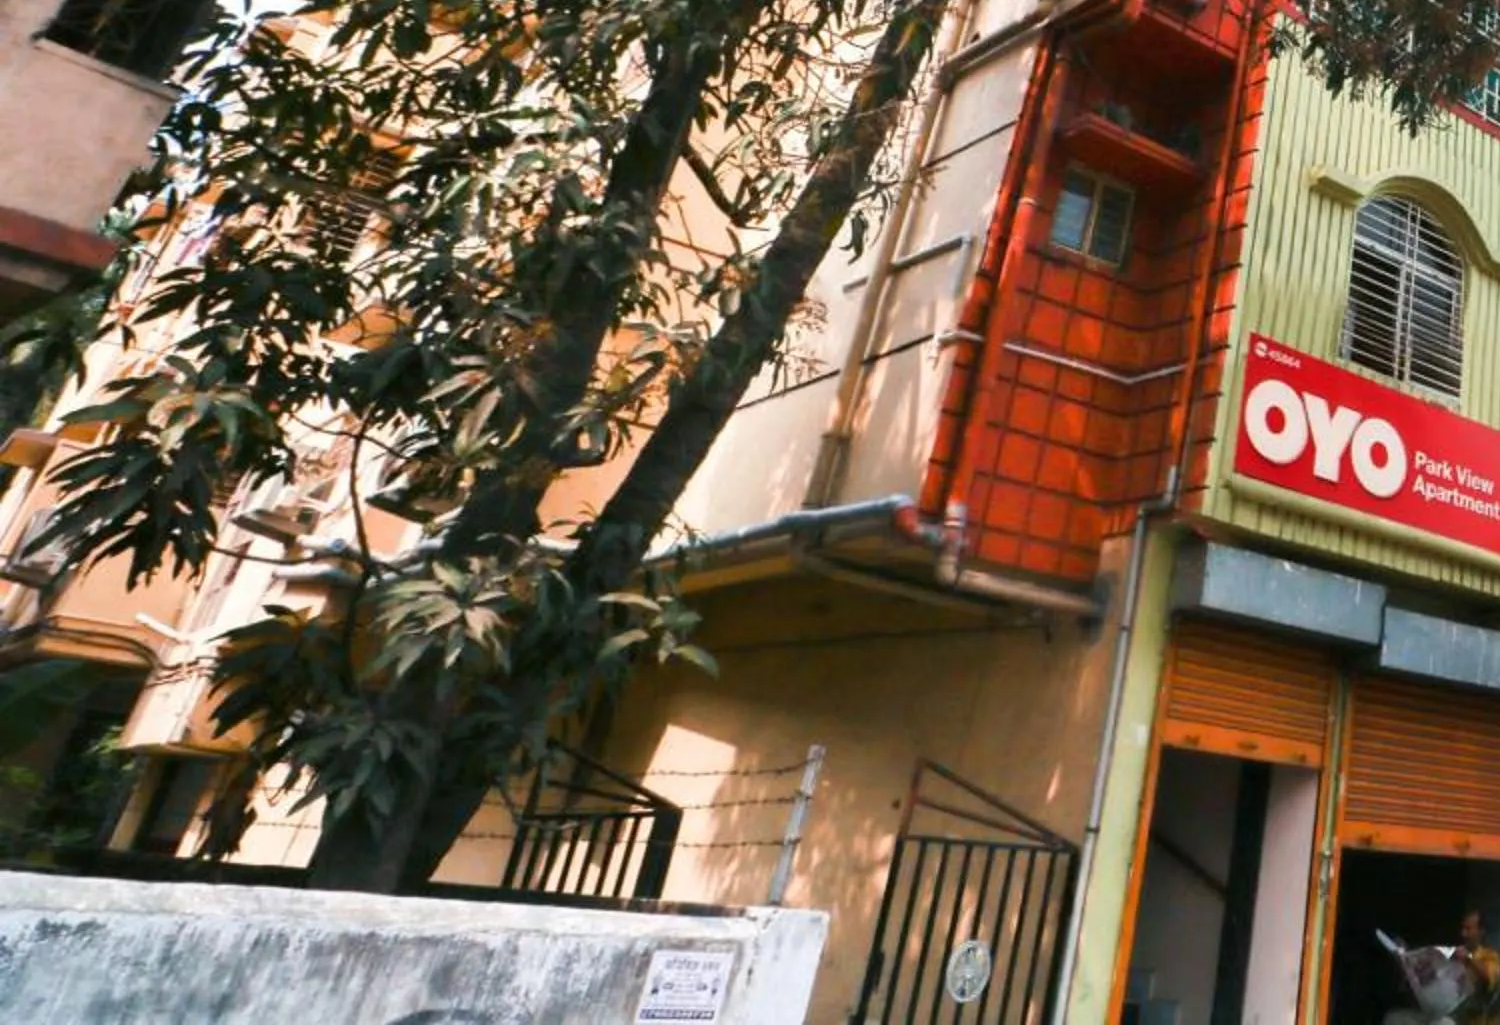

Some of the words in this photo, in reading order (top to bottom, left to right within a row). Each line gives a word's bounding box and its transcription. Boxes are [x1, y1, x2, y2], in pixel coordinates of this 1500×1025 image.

[1244, 378, 1408, 498] OYO
[1415, 450, 1453, 481] Park
[1455, 464, 1495, 494] View
[1412, 474, 1500, 520] Apartment
